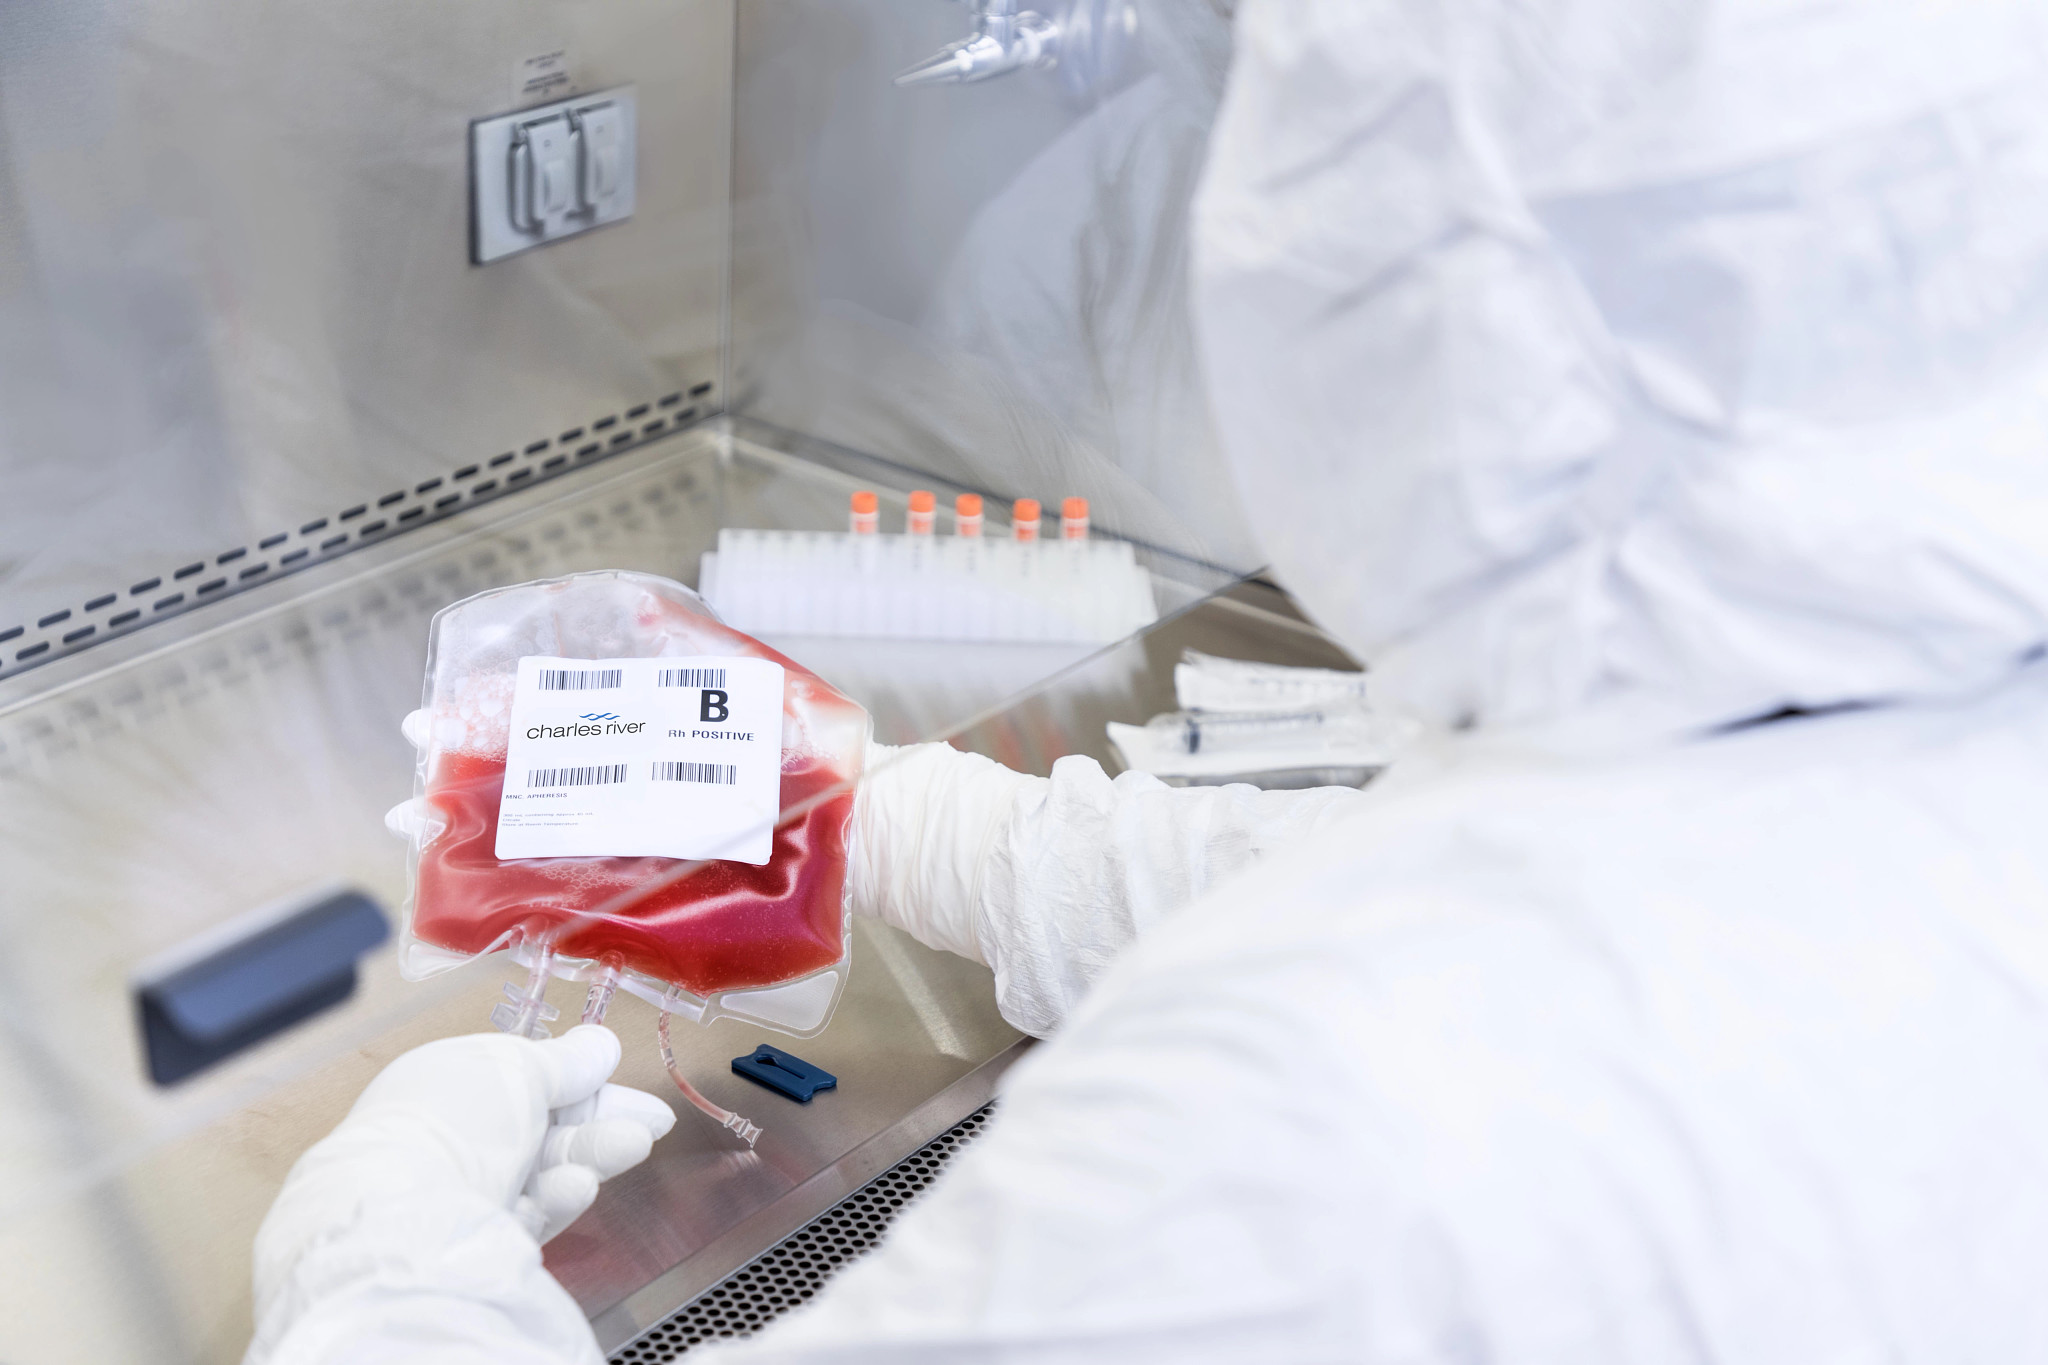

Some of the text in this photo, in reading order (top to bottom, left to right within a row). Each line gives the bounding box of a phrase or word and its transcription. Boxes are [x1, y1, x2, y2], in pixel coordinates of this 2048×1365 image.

[700, 689, 729, 722] B
[526, 720, 646, 740] charles river
[668, 729, 755, 742] Rh POSITIVE
